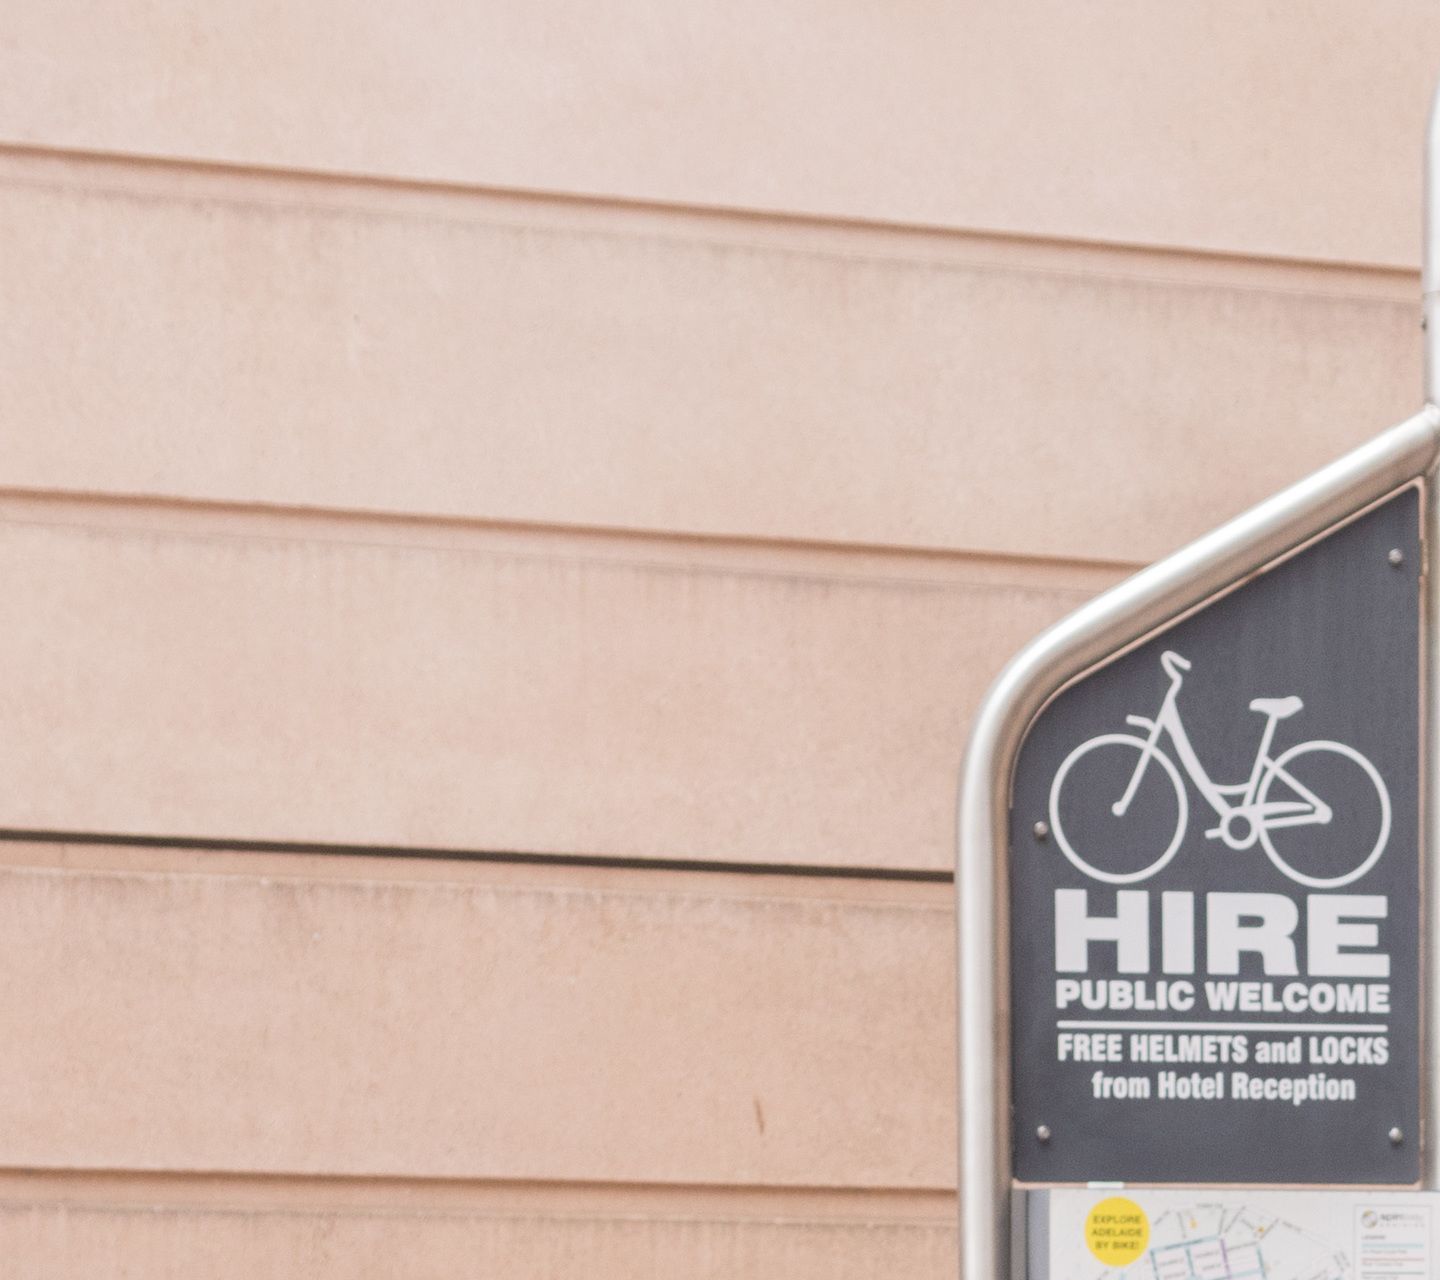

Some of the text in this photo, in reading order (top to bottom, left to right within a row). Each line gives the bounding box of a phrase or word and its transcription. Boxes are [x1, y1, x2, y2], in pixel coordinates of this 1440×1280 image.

[1055, 889, 1390, 977] HIRE
[1055, 980, 1390, 1013] PUBLIC WELCOME
[1057, 1034, 1389, 1065] FREE HELMETS and LOCKS
[1092, 1071, 1356, 1106] from Hotel Reception
[1091, 1228, 1143, 1236] ADELAIDE
[1093, 1215, 1141, 1224] EXPLORE
[1095, 1241, 1109, 1249] BY
